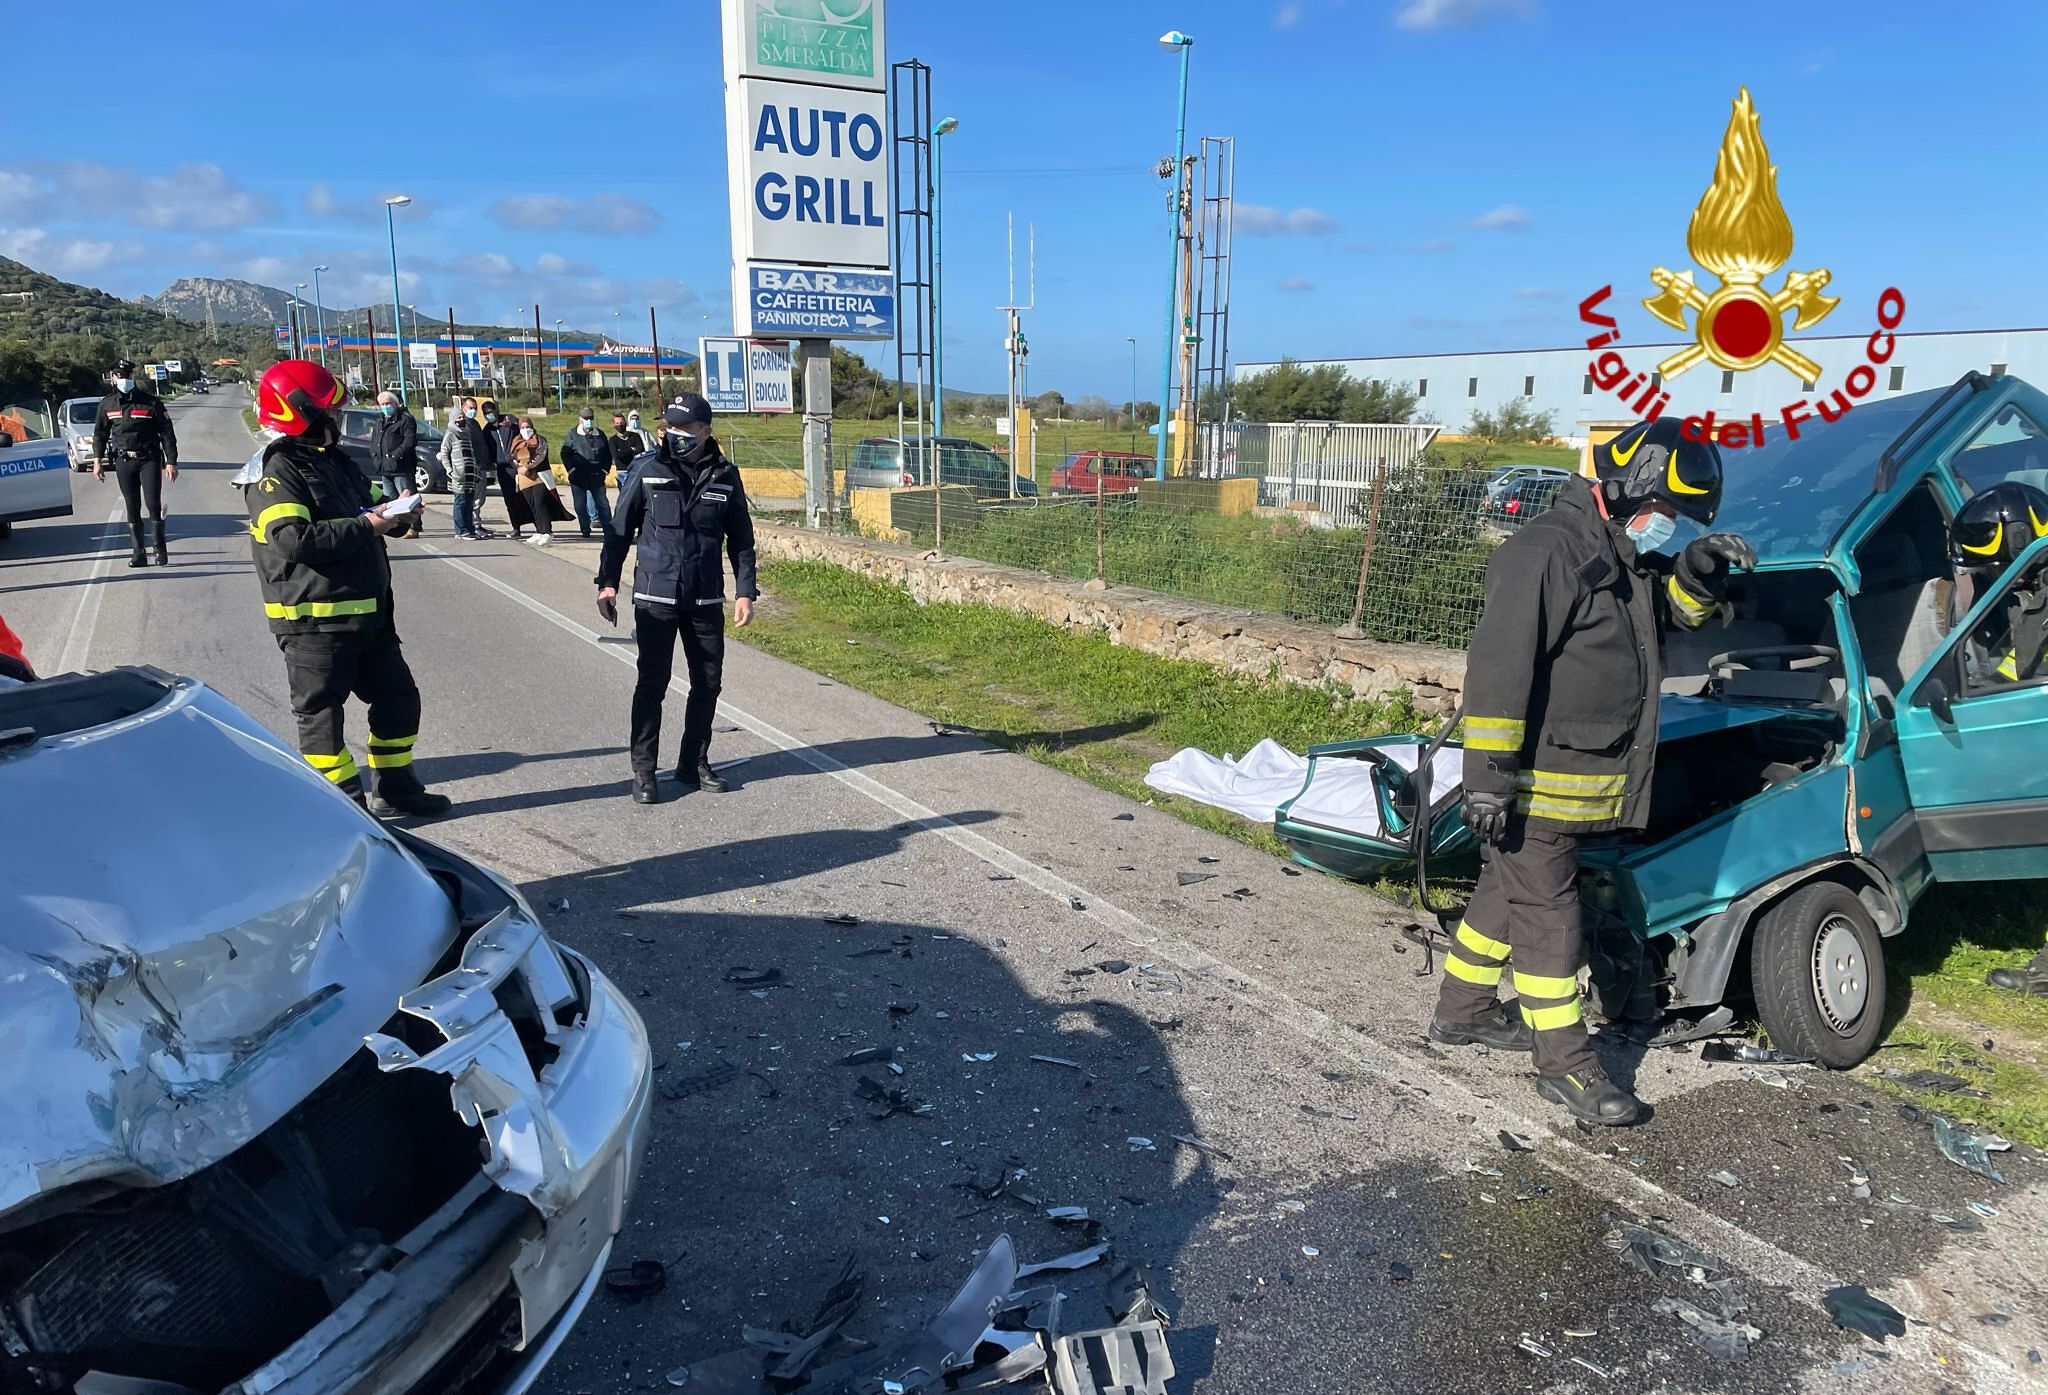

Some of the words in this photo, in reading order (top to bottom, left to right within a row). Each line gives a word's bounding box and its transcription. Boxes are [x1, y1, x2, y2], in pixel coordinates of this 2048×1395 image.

[762, 21, 868, 51] PIAZZA
[761, 42, 868, 71] SMERALDA
[754, 104, 883, 162] AUTO
[755, 171, 884, 227] GRILL
[757, 270, 838, 293] BAR
[756, 292, 876, 313] CAFFETTERIA
[757, 311, 850, 328] PANINOTECA
[752, 351, 788, 371] GIORNALI
[755, 382, 788, 402] EDICOLA
[0, 459, 46, 475] POLIZIA
